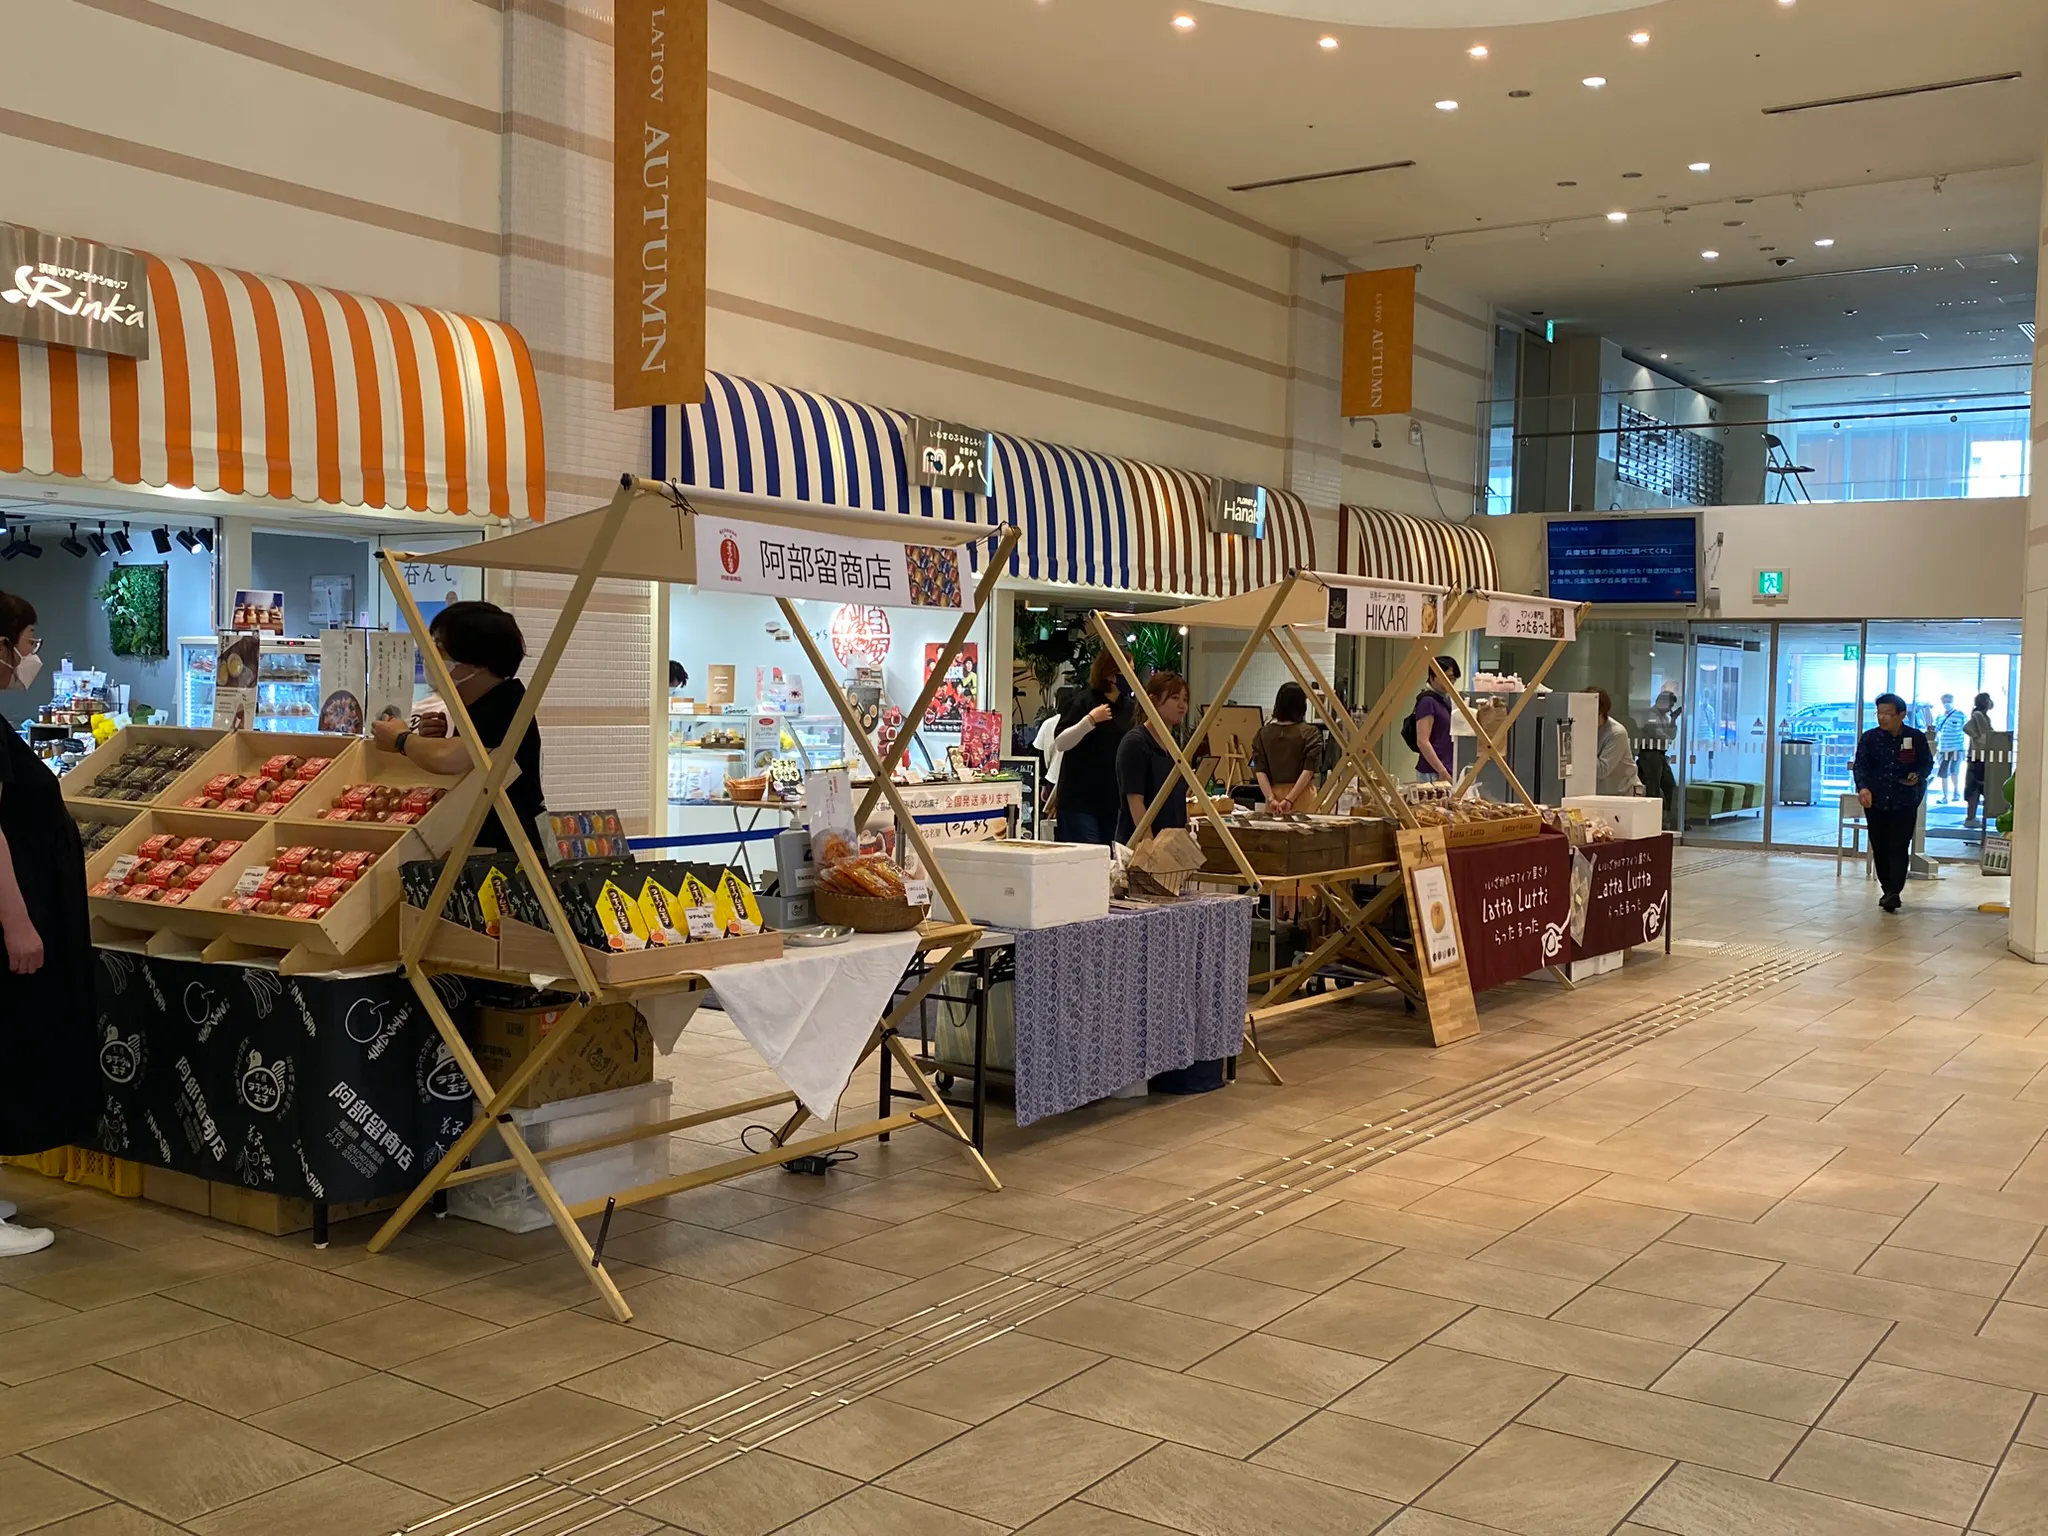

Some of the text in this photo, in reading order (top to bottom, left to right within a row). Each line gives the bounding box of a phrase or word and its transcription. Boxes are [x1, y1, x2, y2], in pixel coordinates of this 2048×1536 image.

[641, 6, 670, 373] LATOV AUTUMN
[1371, 328, 1384, 408] AUTUMN
[759, 540, 892, 590] 阿部留商店
[1365, 603, 1408, 632] HIKARI
[1515, 618, 1550, 635] らったるった
[944, 792, 1011, 808] 全国発送承ります
[1626, 869, 1652, 892] Lutta
[1483, 896, 1513, 924] Latta
[1494, 917, 1539, 946] らったるった
[174, 1056, 227, 1162] 阿部留商店
[324, 1131, 342, 1150] FAX
[328, 1081, 415, 1171] 阿部留商店
[331, 1126, 345, 1144] TEL
